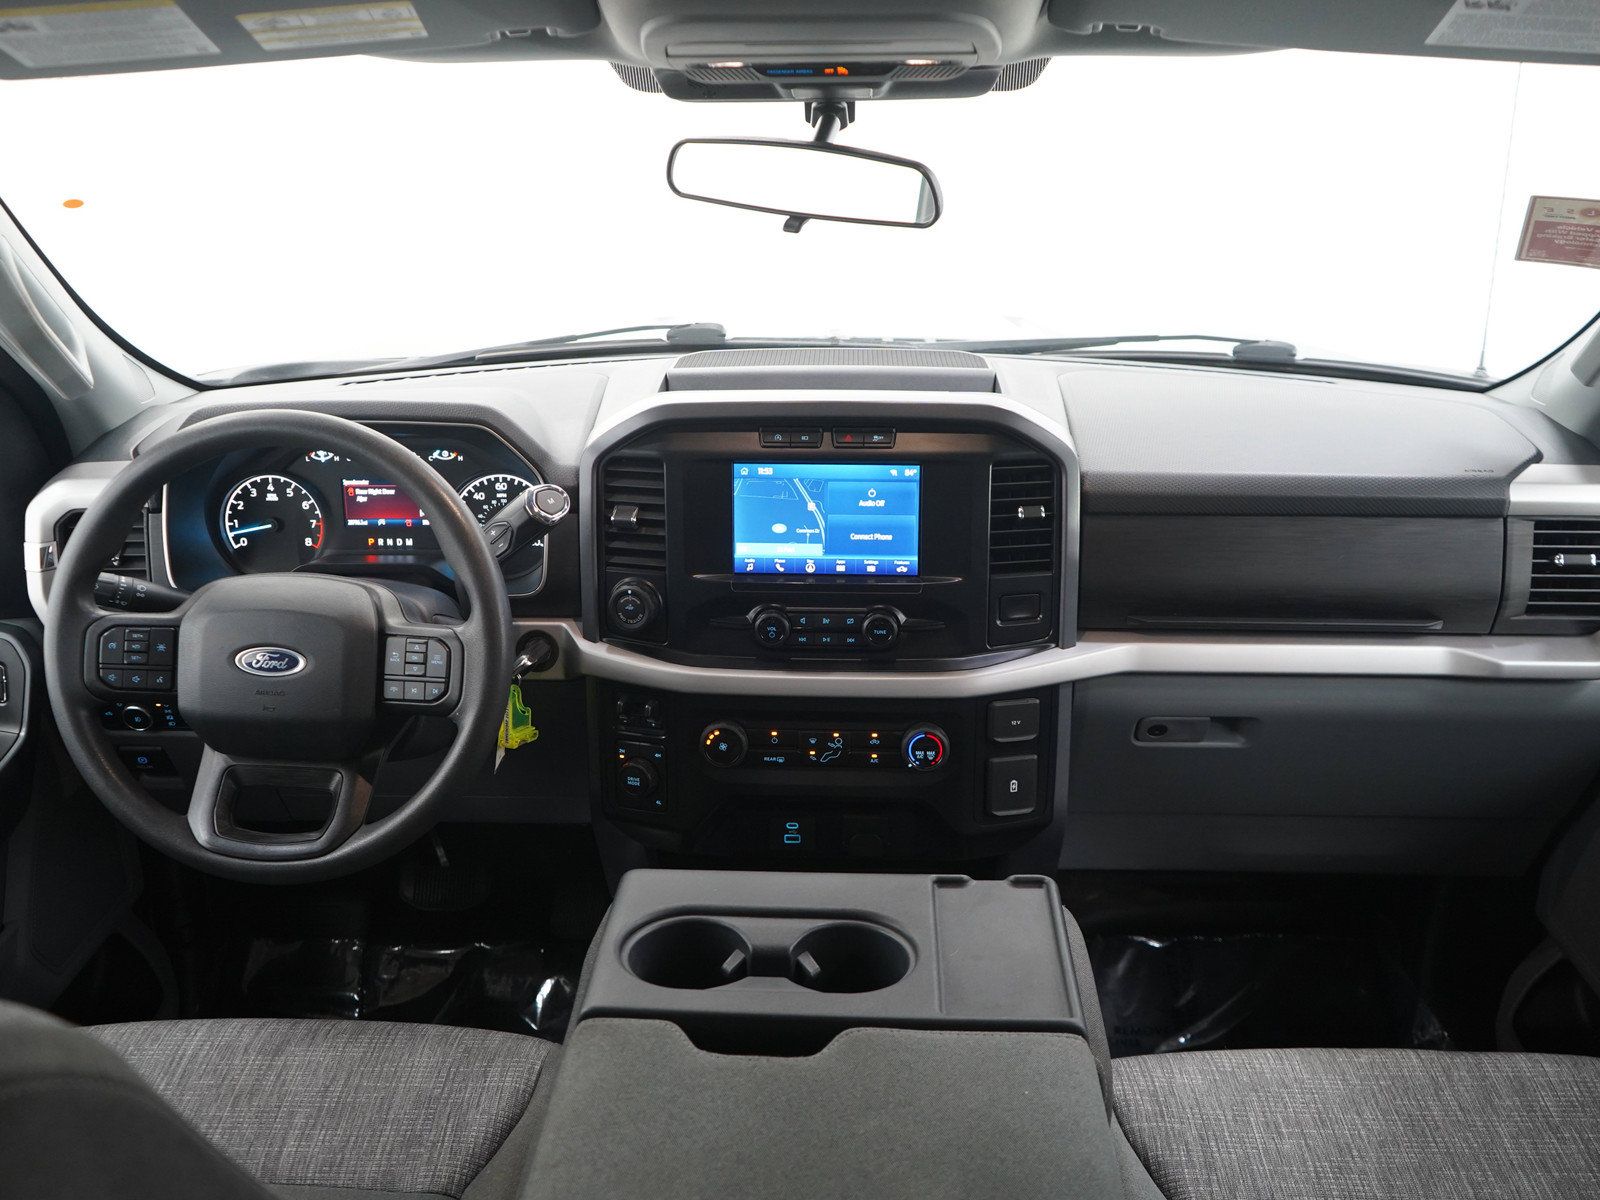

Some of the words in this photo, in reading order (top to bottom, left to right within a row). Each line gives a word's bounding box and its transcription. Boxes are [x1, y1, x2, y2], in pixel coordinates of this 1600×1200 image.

[266, 483, 275, 492] 4
[495, 483, 508, 491] 60
[249, 488, 257, 497] 3
[285, 488, 294, 497] 5
[472, 492, 486, 501] 40
[237, 500, 245, 510] 2
[301, 500, 310, 510] 6
[309, 519, 317, 529] 7
[873, 533, 893, 541] Phone
[240, 537, 248, 547] 0
[304, 537, 313, 547] 8
[368, 538, 375, 546] P
[377, 538, 384, 546] R
[386, 538, 394, 546] N
[396, 538, 403, 546] D
[405, 538, 413, 546] M
[251, 652, 289, 669] Ford
